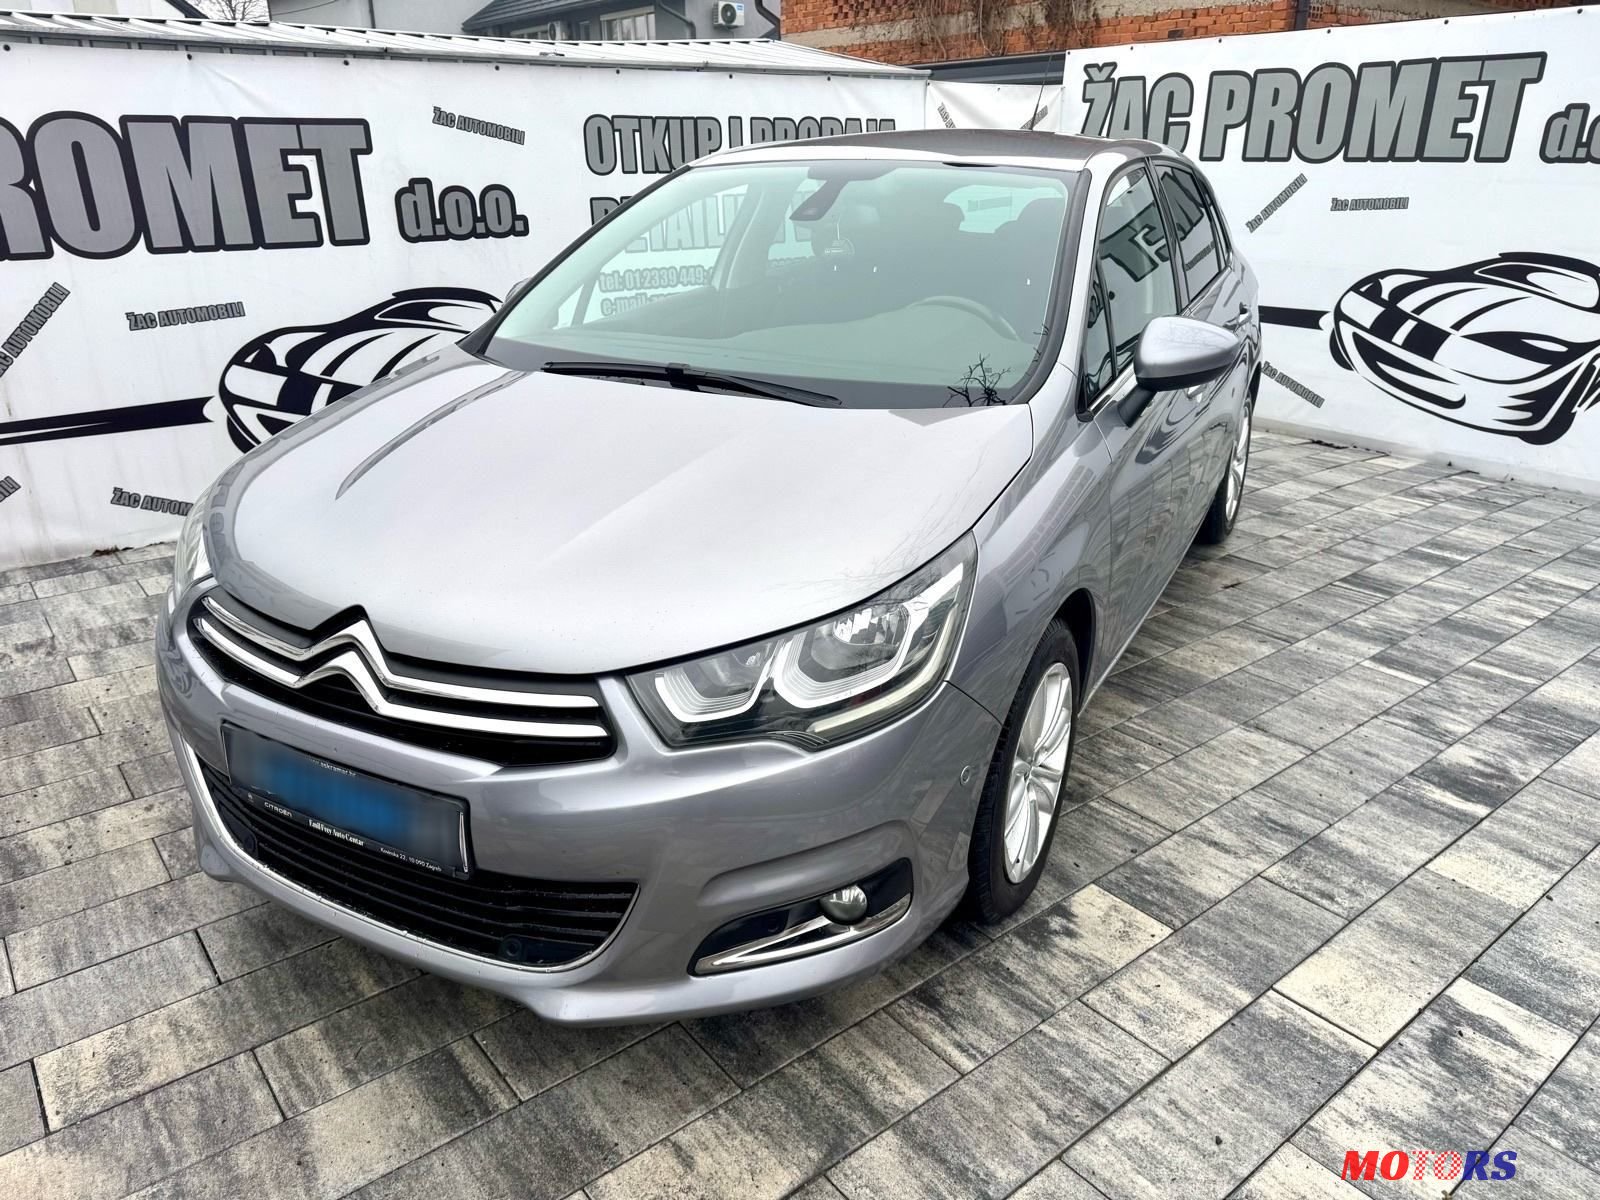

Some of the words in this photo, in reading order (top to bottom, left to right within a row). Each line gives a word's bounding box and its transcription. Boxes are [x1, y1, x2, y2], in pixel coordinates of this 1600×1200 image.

[432, 105, 456, 128] ŽAC
[456, 115, 526, 145] AUTOMOBILI
[1080, 61, 1194, 153] ŽAC
[1199, 51, 1547, 164] PROMET
[583, 114, 722, 176] OTKUP
[394, 178, 529, 243] d.o.o.
[1260, 172, 1308, 221] AUTOMOBILI
[1330, 197, 1349, 211] ŽAC
[1349, 196, 1409, 211] AUTOMOBILI
[1, 281, 71, 359] AUTOMOBILI
[125, 312, 157, 331] ŽAC
[158, 301, 246, 327] AUTOMOBILI
[1274, 371, 1325, 409] AUTOMOBILI
[110, 487, 140, 508] ŽAC
